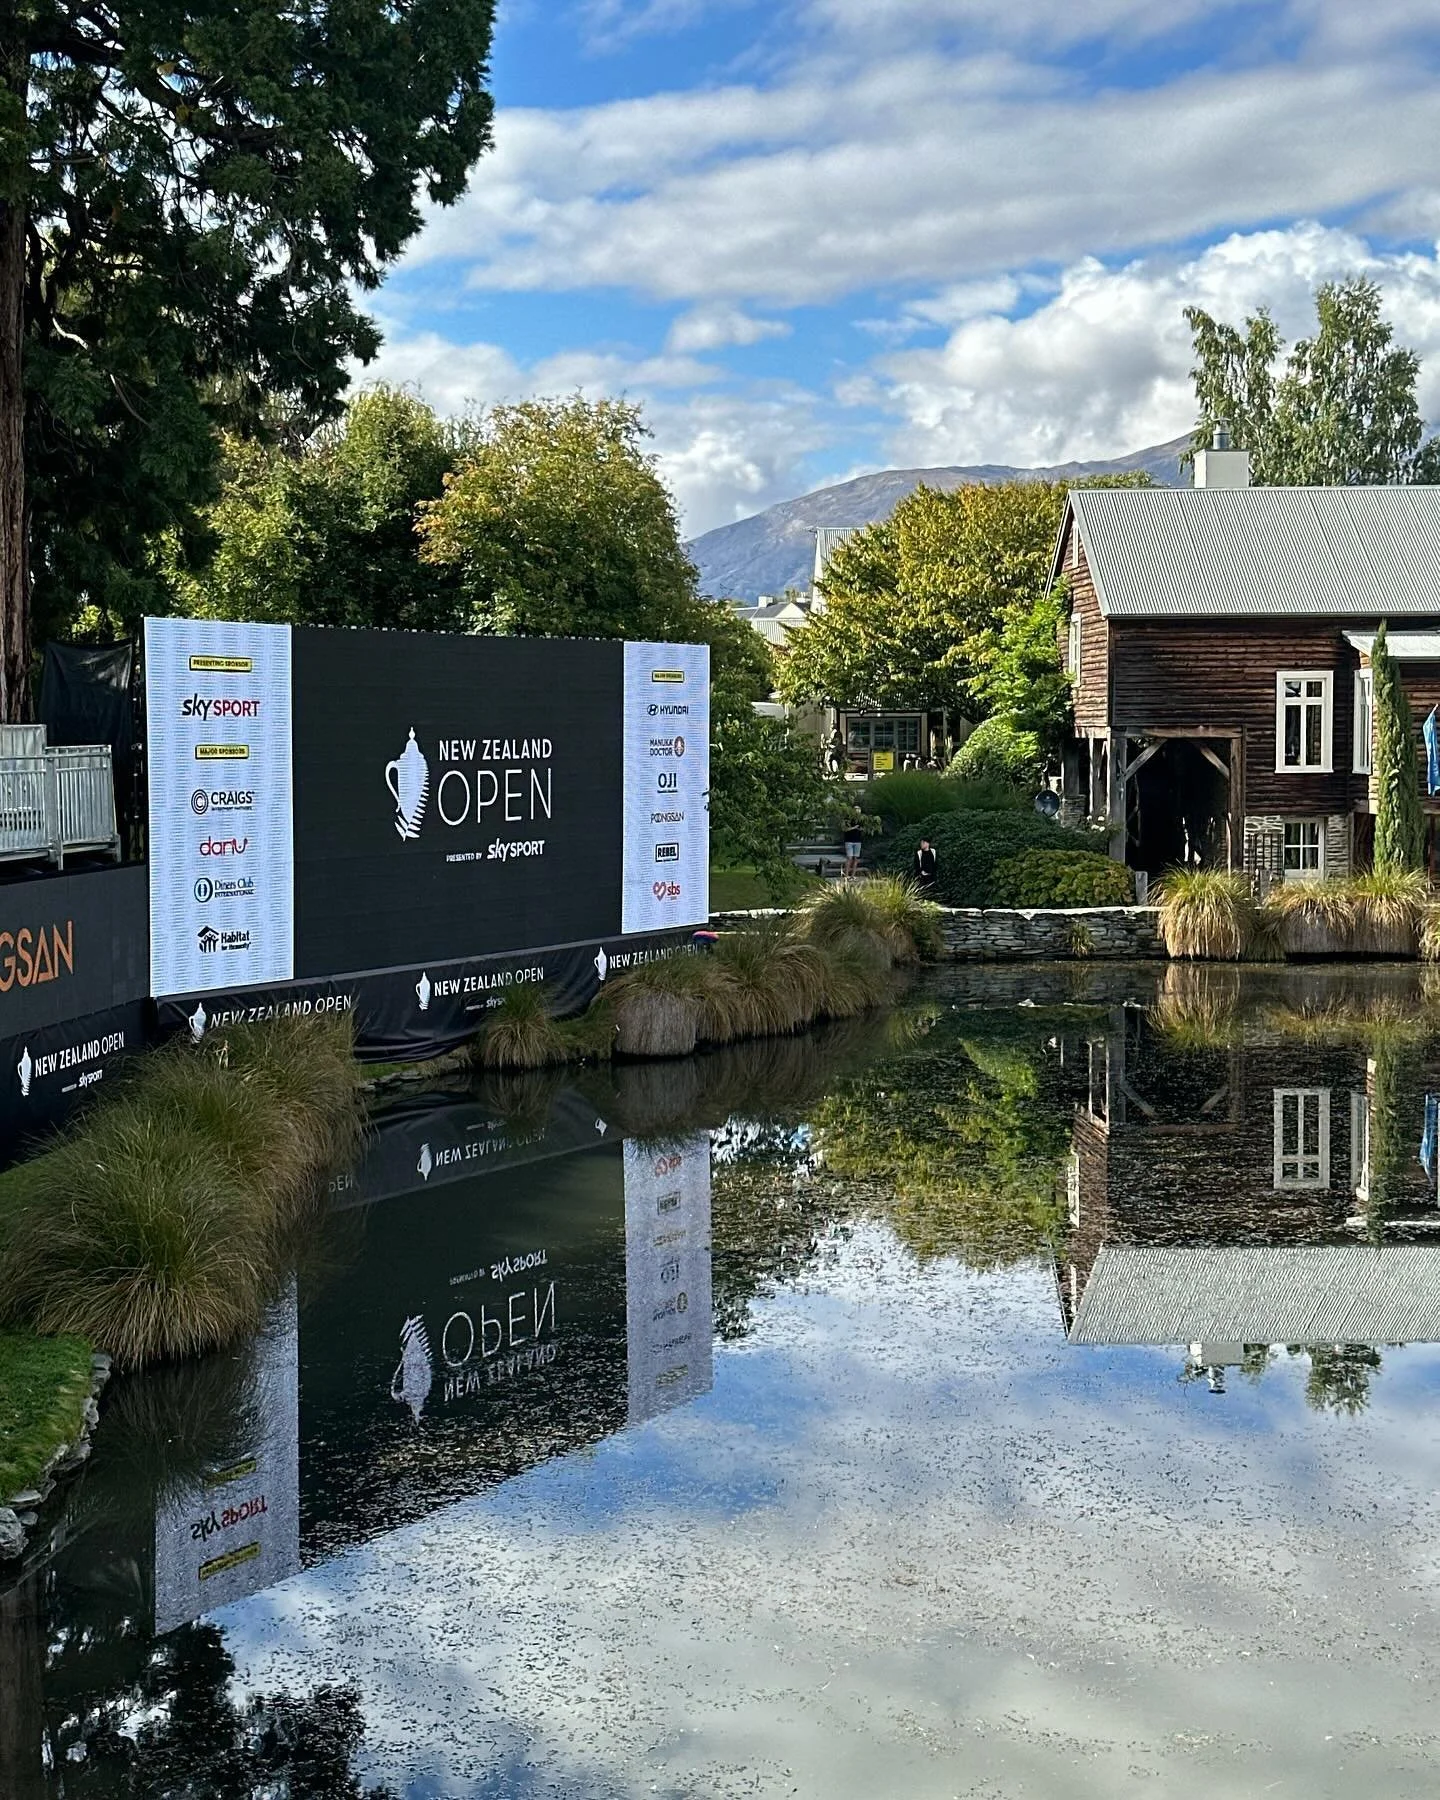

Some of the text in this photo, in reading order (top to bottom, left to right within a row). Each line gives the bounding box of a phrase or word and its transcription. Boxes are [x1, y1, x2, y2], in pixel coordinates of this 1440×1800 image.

[660, 705, 689, 715] HYUNDAI
[439, 738, 553, 761] NEW ZEALAND
[650, 748, 673, 756] DOCTOR
[658, 772, 677, 788] OJI
[210, 790, 253, 805] CRAIGS
[438, 767, 552, 826] OPEN
[446, 852, 482, 862] PRESENTED BY
[214, 876, 254, 890] Diners Club
[221, 930, 250, 944] Habitat
[609, 954, 631, 969] NEW
[434, 966, 544, 997] NEW ZEALAND OPEN
[210, 1009, 246, 1029] NEW
[315, 994, 351, 1014] OPEN
[35, 1031, 124, 1078] NEW ZEALAND OPEN
